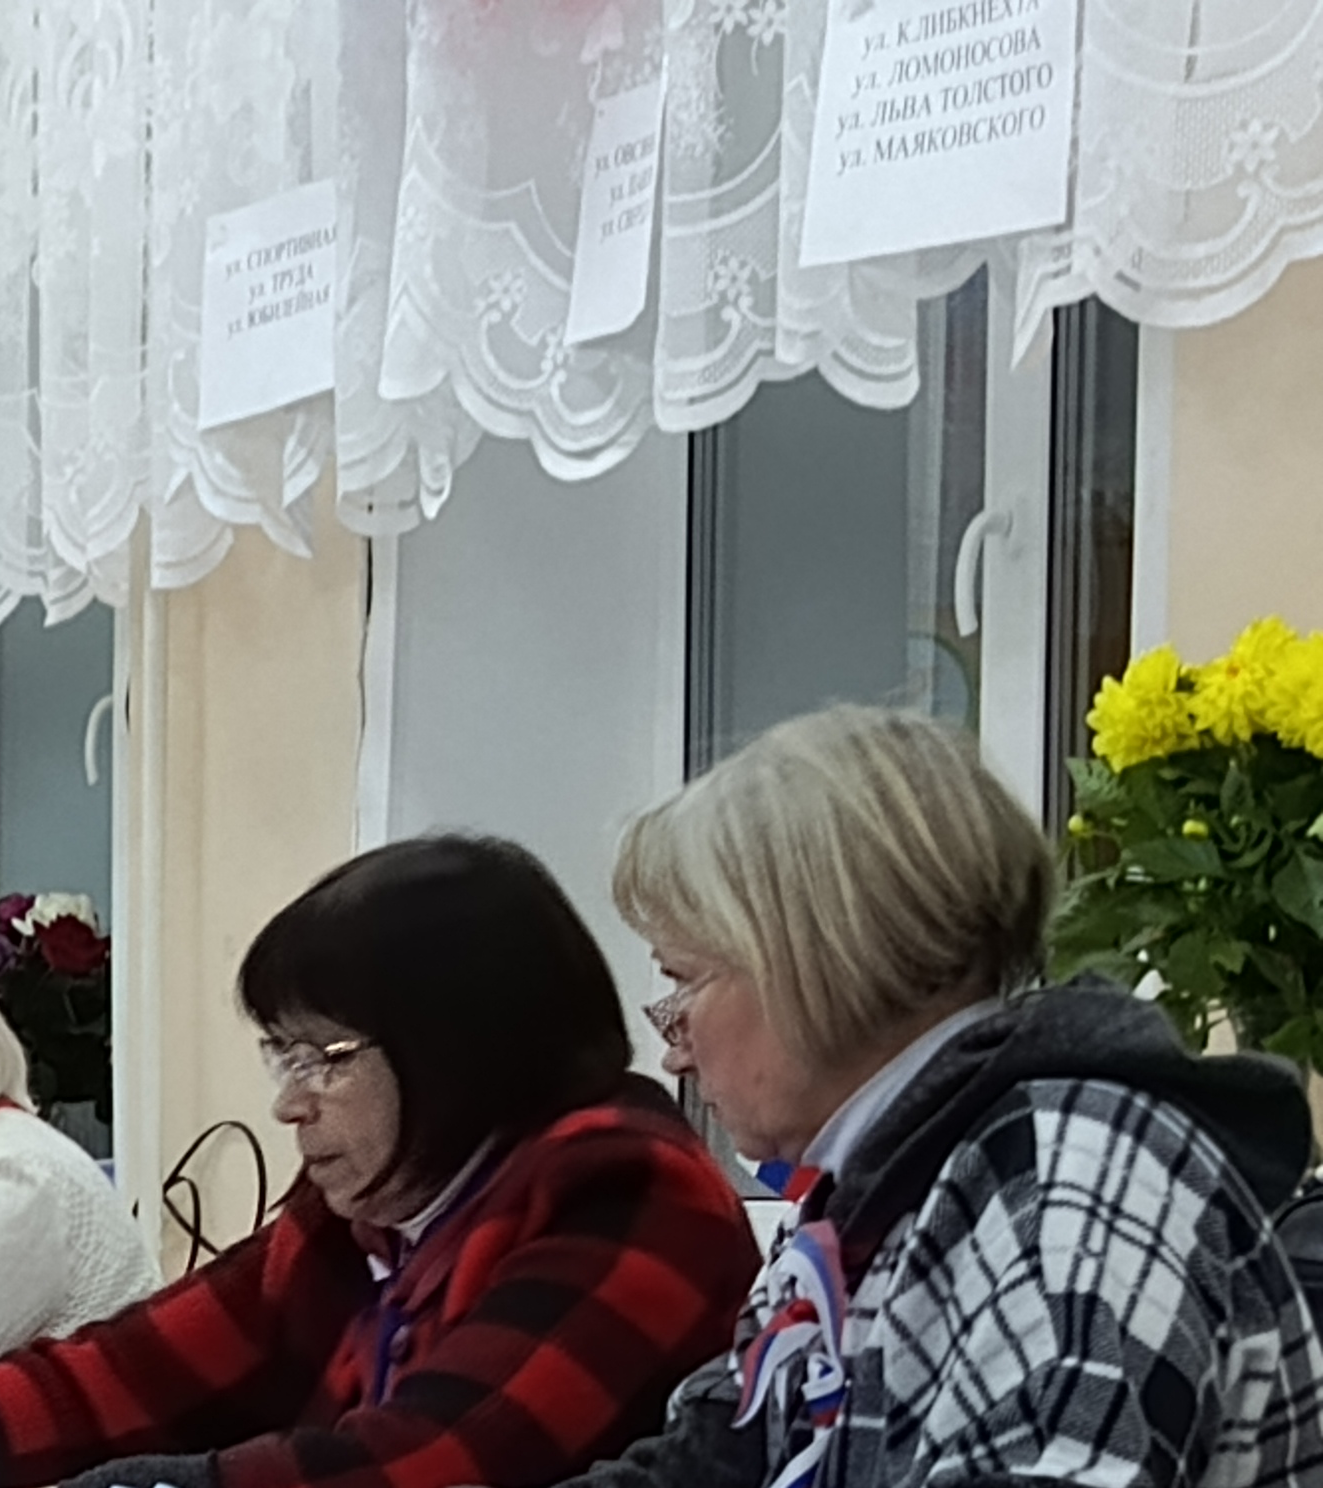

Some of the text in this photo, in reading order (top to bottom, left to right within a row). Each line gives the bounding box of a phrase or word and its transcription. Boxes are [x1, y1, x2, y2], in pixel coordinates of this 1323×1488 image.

[851, 24, 1041, 99] ул. ЛОМОНОСОВА
[862, 32, 890, 60] ул.
[836, 62, 1054, 140] ул. ЛЬВА ТОЛСТОГО
[837, 104, 1046, 176] ул. МАЯКОВСКОГО
[247, 283, 331, 328] ЮБИЛЕЙНАЯ
[272, 261, 314, 293] ТРУДА
